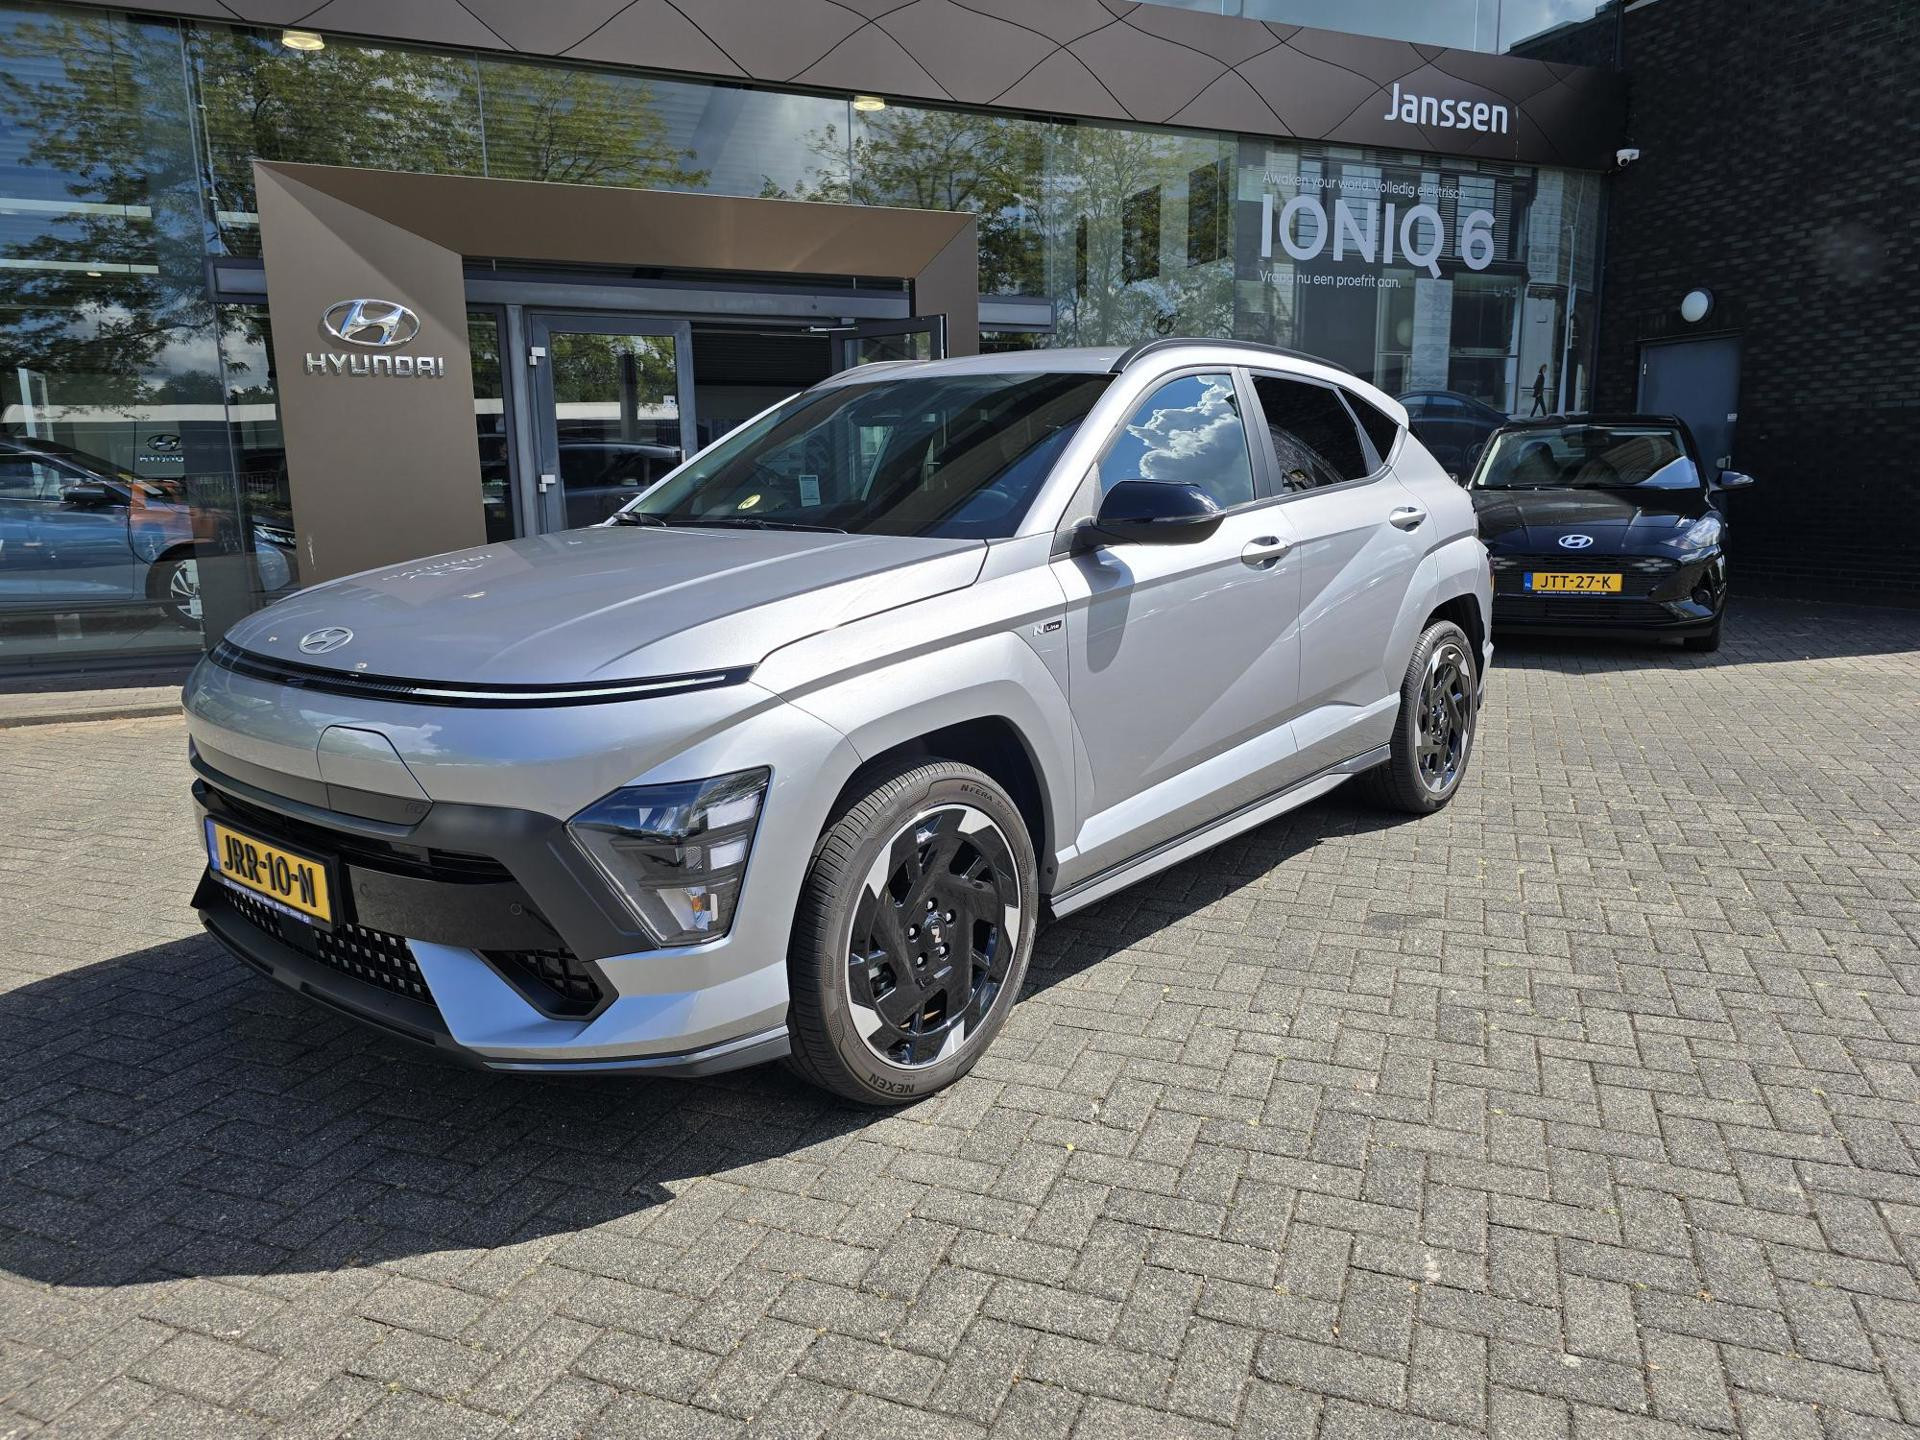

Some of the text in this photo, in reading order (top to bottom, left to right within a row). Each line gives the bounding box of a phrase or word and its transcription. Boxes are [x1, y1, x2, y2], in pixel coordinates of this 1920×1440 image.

[1383, 82, 1508, 134] Janssen
[1262, 170, 1308, 187] Awaken
[1310, 177, 1336, 190] your
[1374, 180, 1415, 198] Volledig
[1261, 193, 1496, 280] IONIQ 6
[1259, 270, 1401, 289] Vraag nu een proefrit aan.
[305, 352, 446, 377] HYUNDAI
[1540, 575, 1612, 590] JTT-27-K
[1032, 622, 1045, 636] N
[223, 834, 318, 908] JRR-10-N
[868, 1072, 916, 1095] NEXEN
